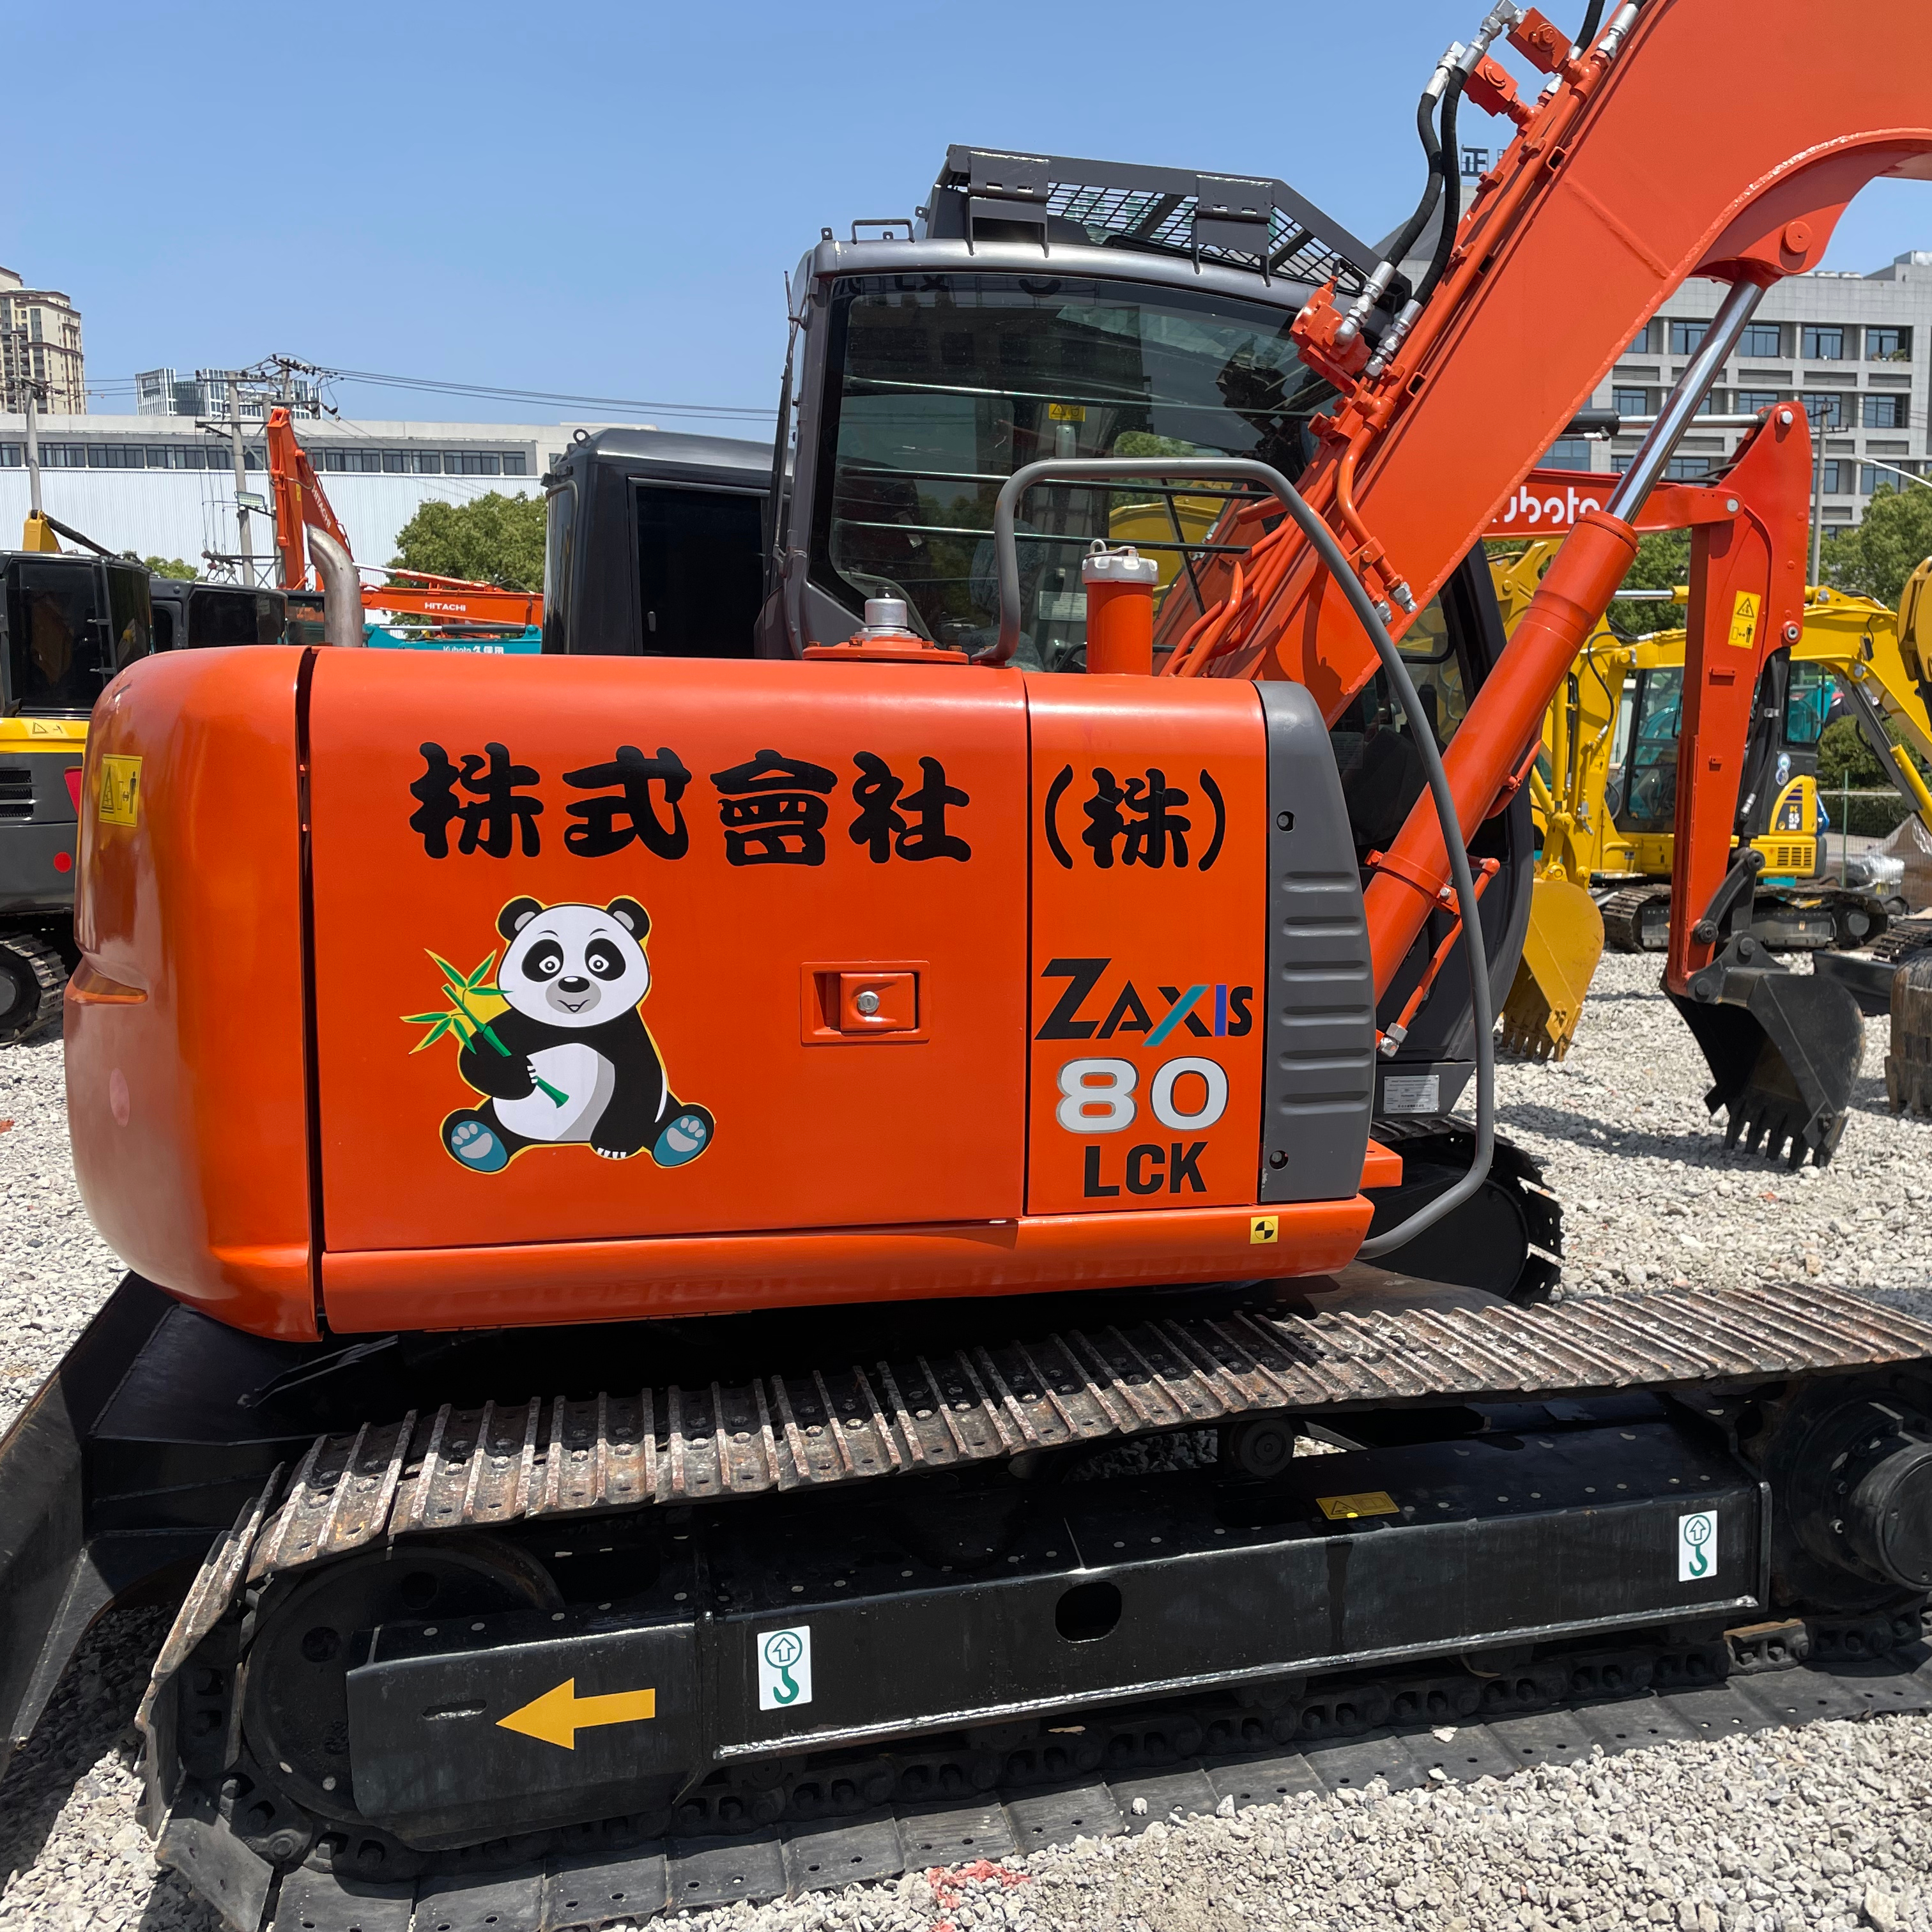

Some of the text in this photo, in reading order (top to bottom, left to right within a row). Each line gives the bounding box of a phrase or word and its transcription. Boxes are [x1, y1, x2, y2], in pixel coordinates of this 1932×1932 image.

[1460, 147, 1506, 176] 正
[311, 485, 332, 529] HITACHI
[1492, 486, 1600, 524] ubota
[424, 602, 466, 612] HITACHI
[1055, 1056, 1229, 1134] 80
[1084, 1141, 1209, 1198] LCK
